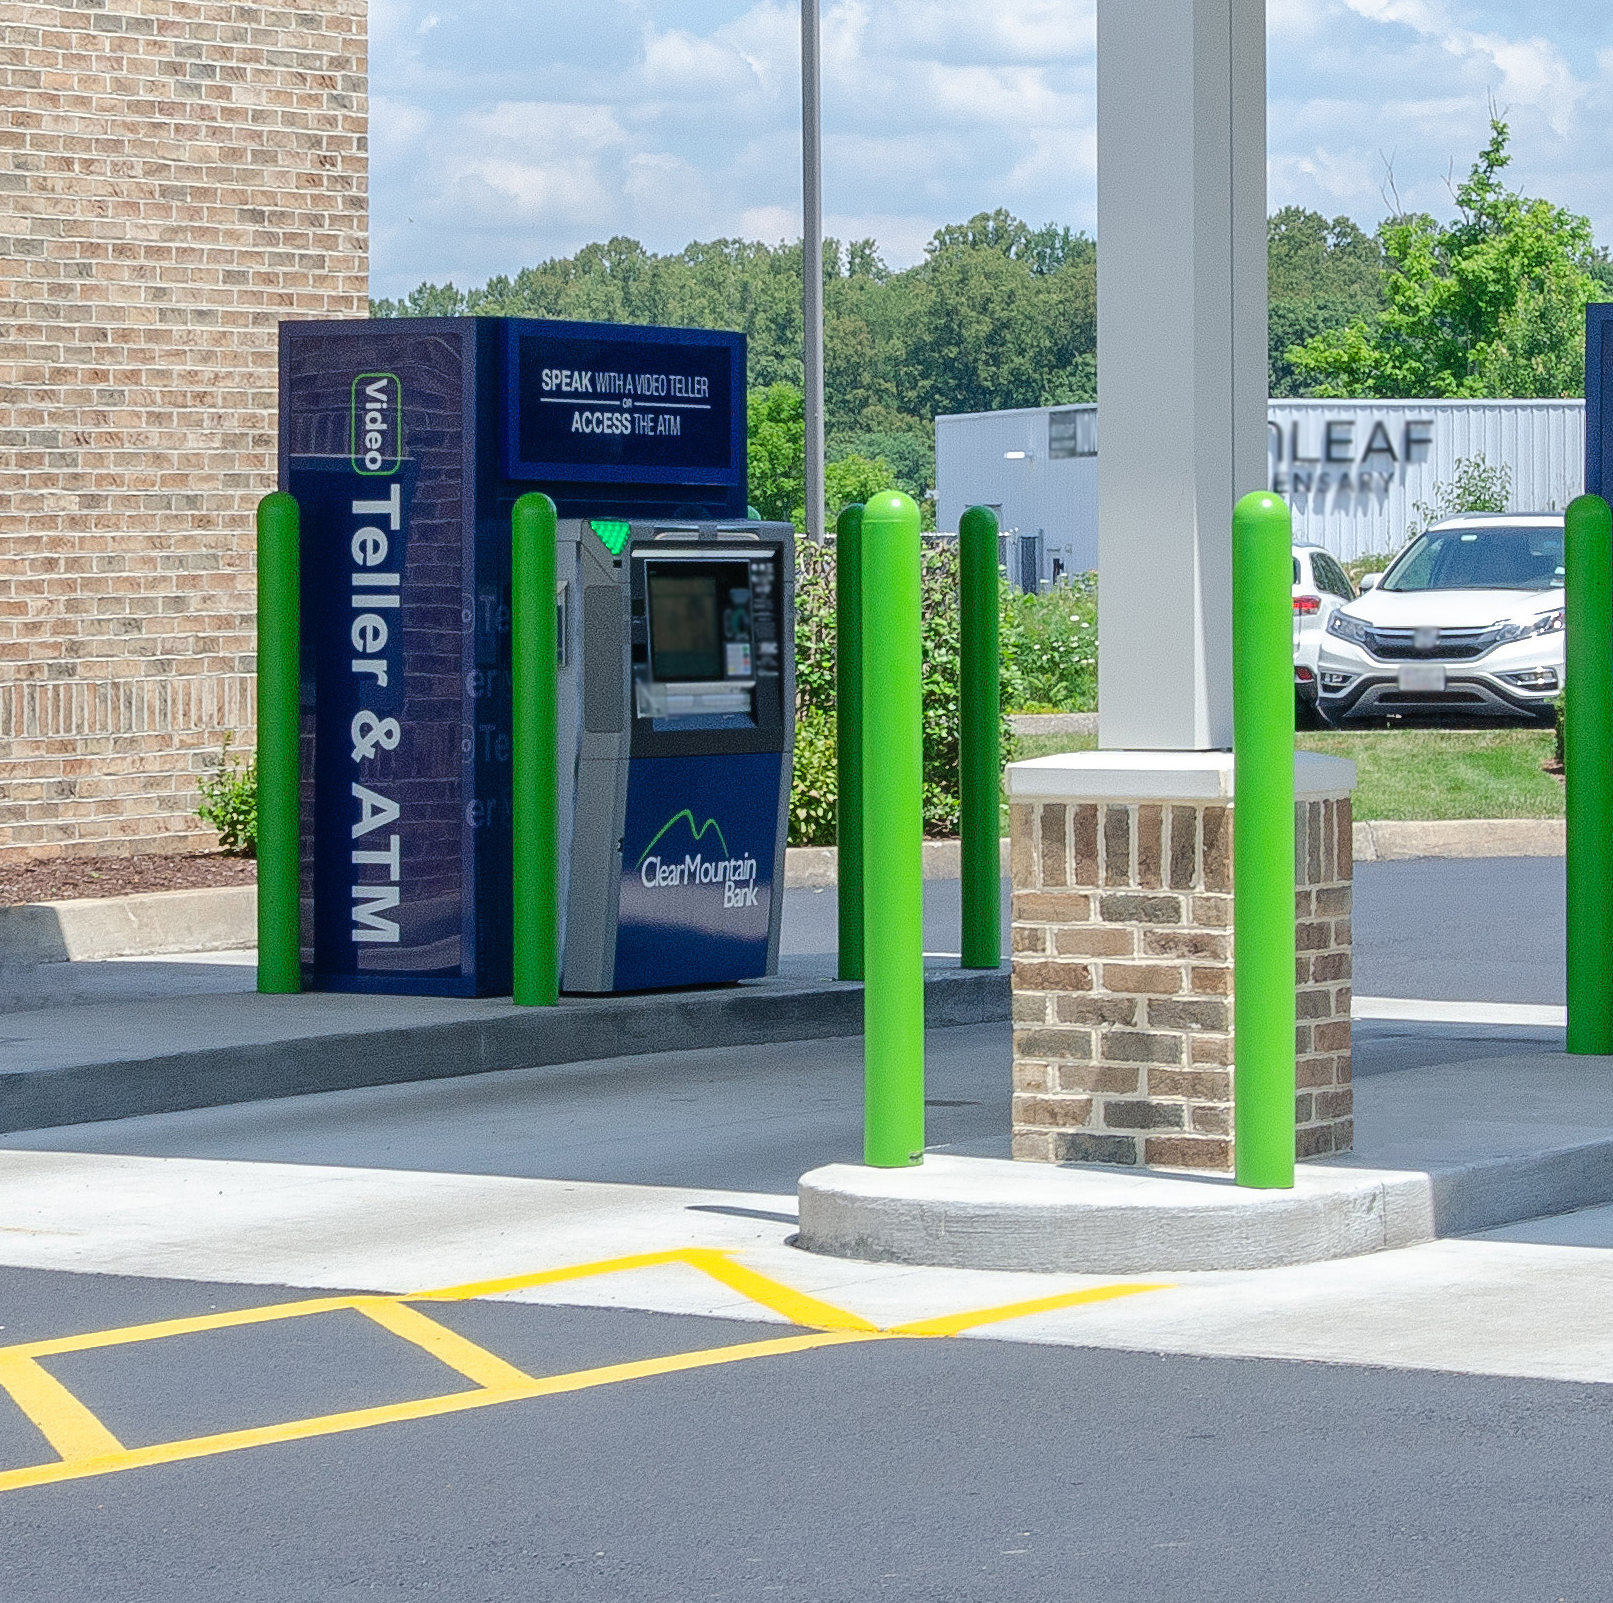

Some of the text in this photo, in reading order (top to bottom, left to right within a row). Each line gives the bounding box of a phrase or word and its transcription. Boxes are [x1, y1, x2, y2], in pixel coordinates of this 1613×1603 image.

[541, 368, 709, 398] SPEAK WITH A VIDEO TELLER
[571, 411, 681, 436] ACCESS THE ATM
[1273, 470, 1395, 494] ENSARY
[350, 378, 401, 944] Video Teller & ATM
[641, 852, 757, 888] ClearMountain
[723, 879, 758, 908] Bank
